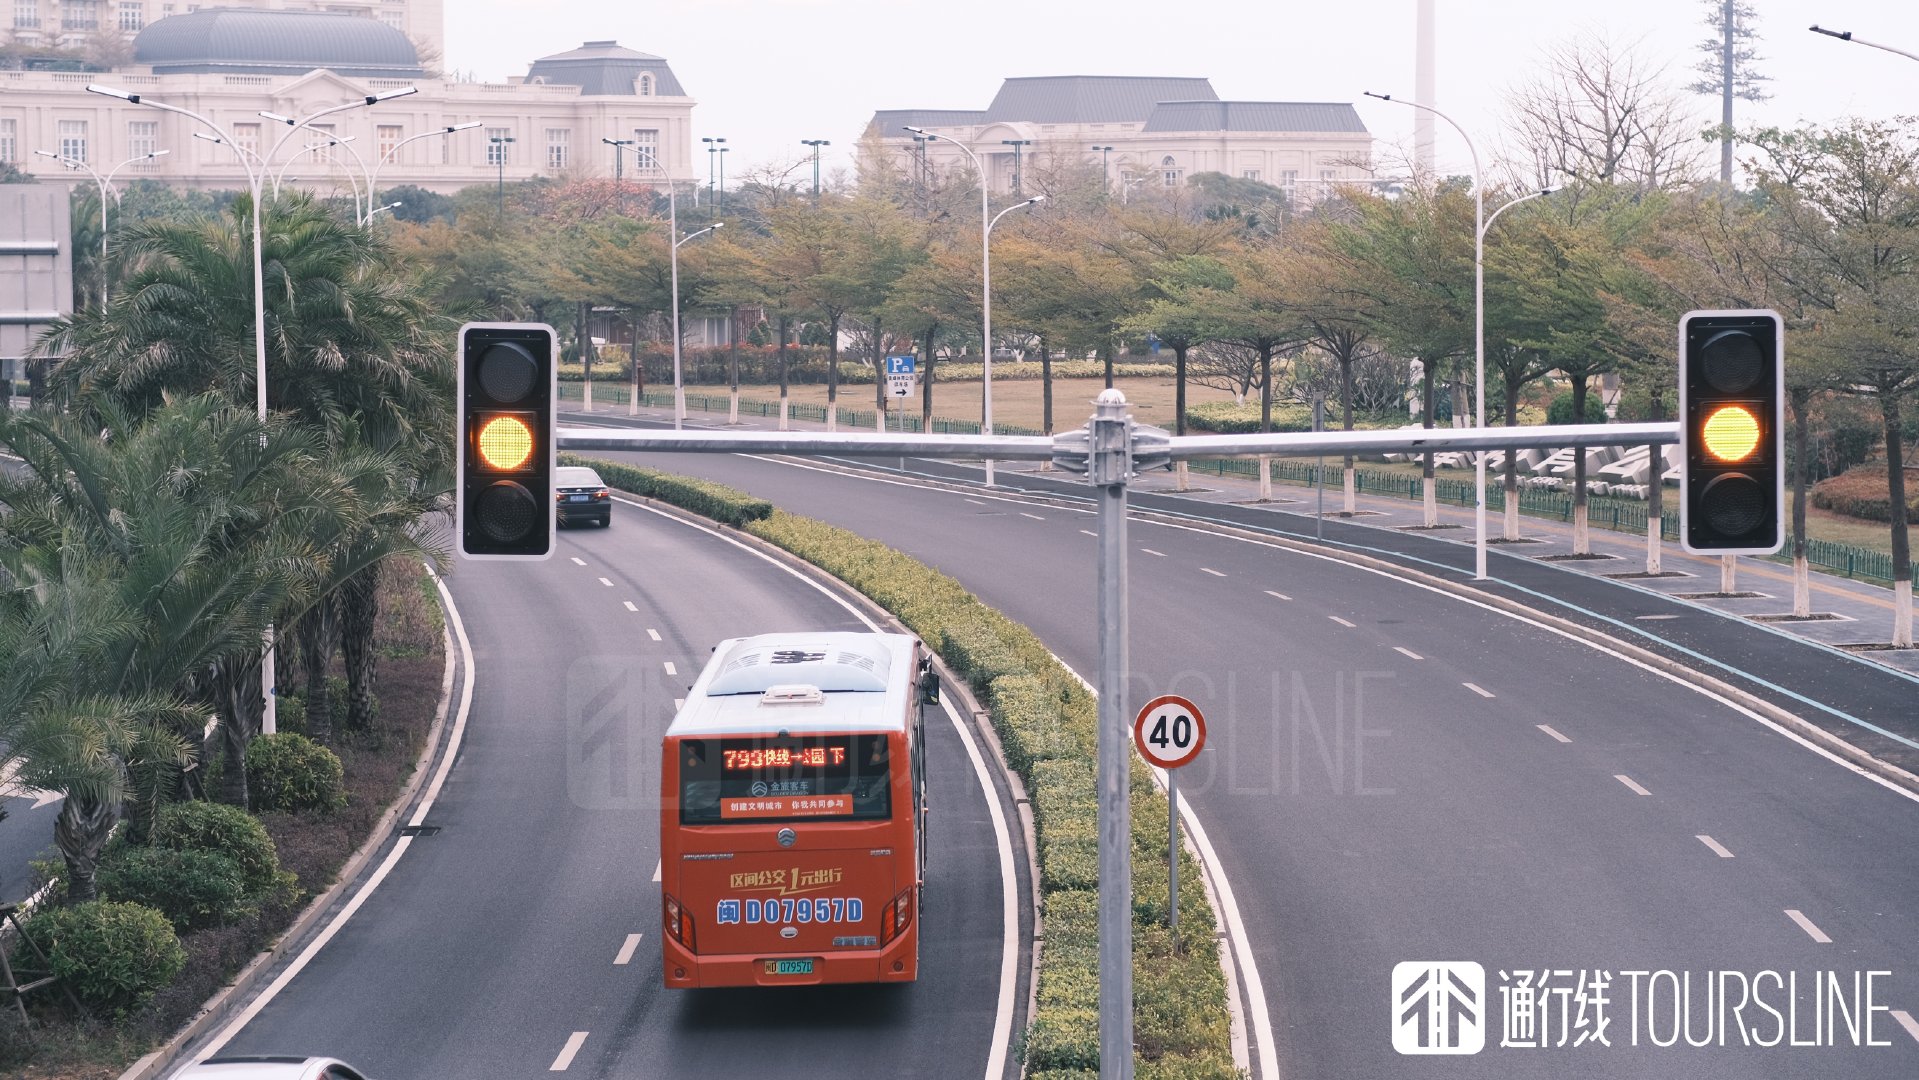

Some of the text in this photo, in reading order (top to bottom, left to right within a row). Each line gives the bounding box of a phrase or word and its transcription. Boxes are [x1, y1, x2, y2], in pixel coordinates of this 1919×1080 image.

[891, 358, 903, 373] P
[1149, 715, 1191, 748] 40
[830, 747, 844, 764] 下
[770, 781, 809, 792] 金旅客车
[730, 799, 844, 811] 创建文明城市 你我共同参与
